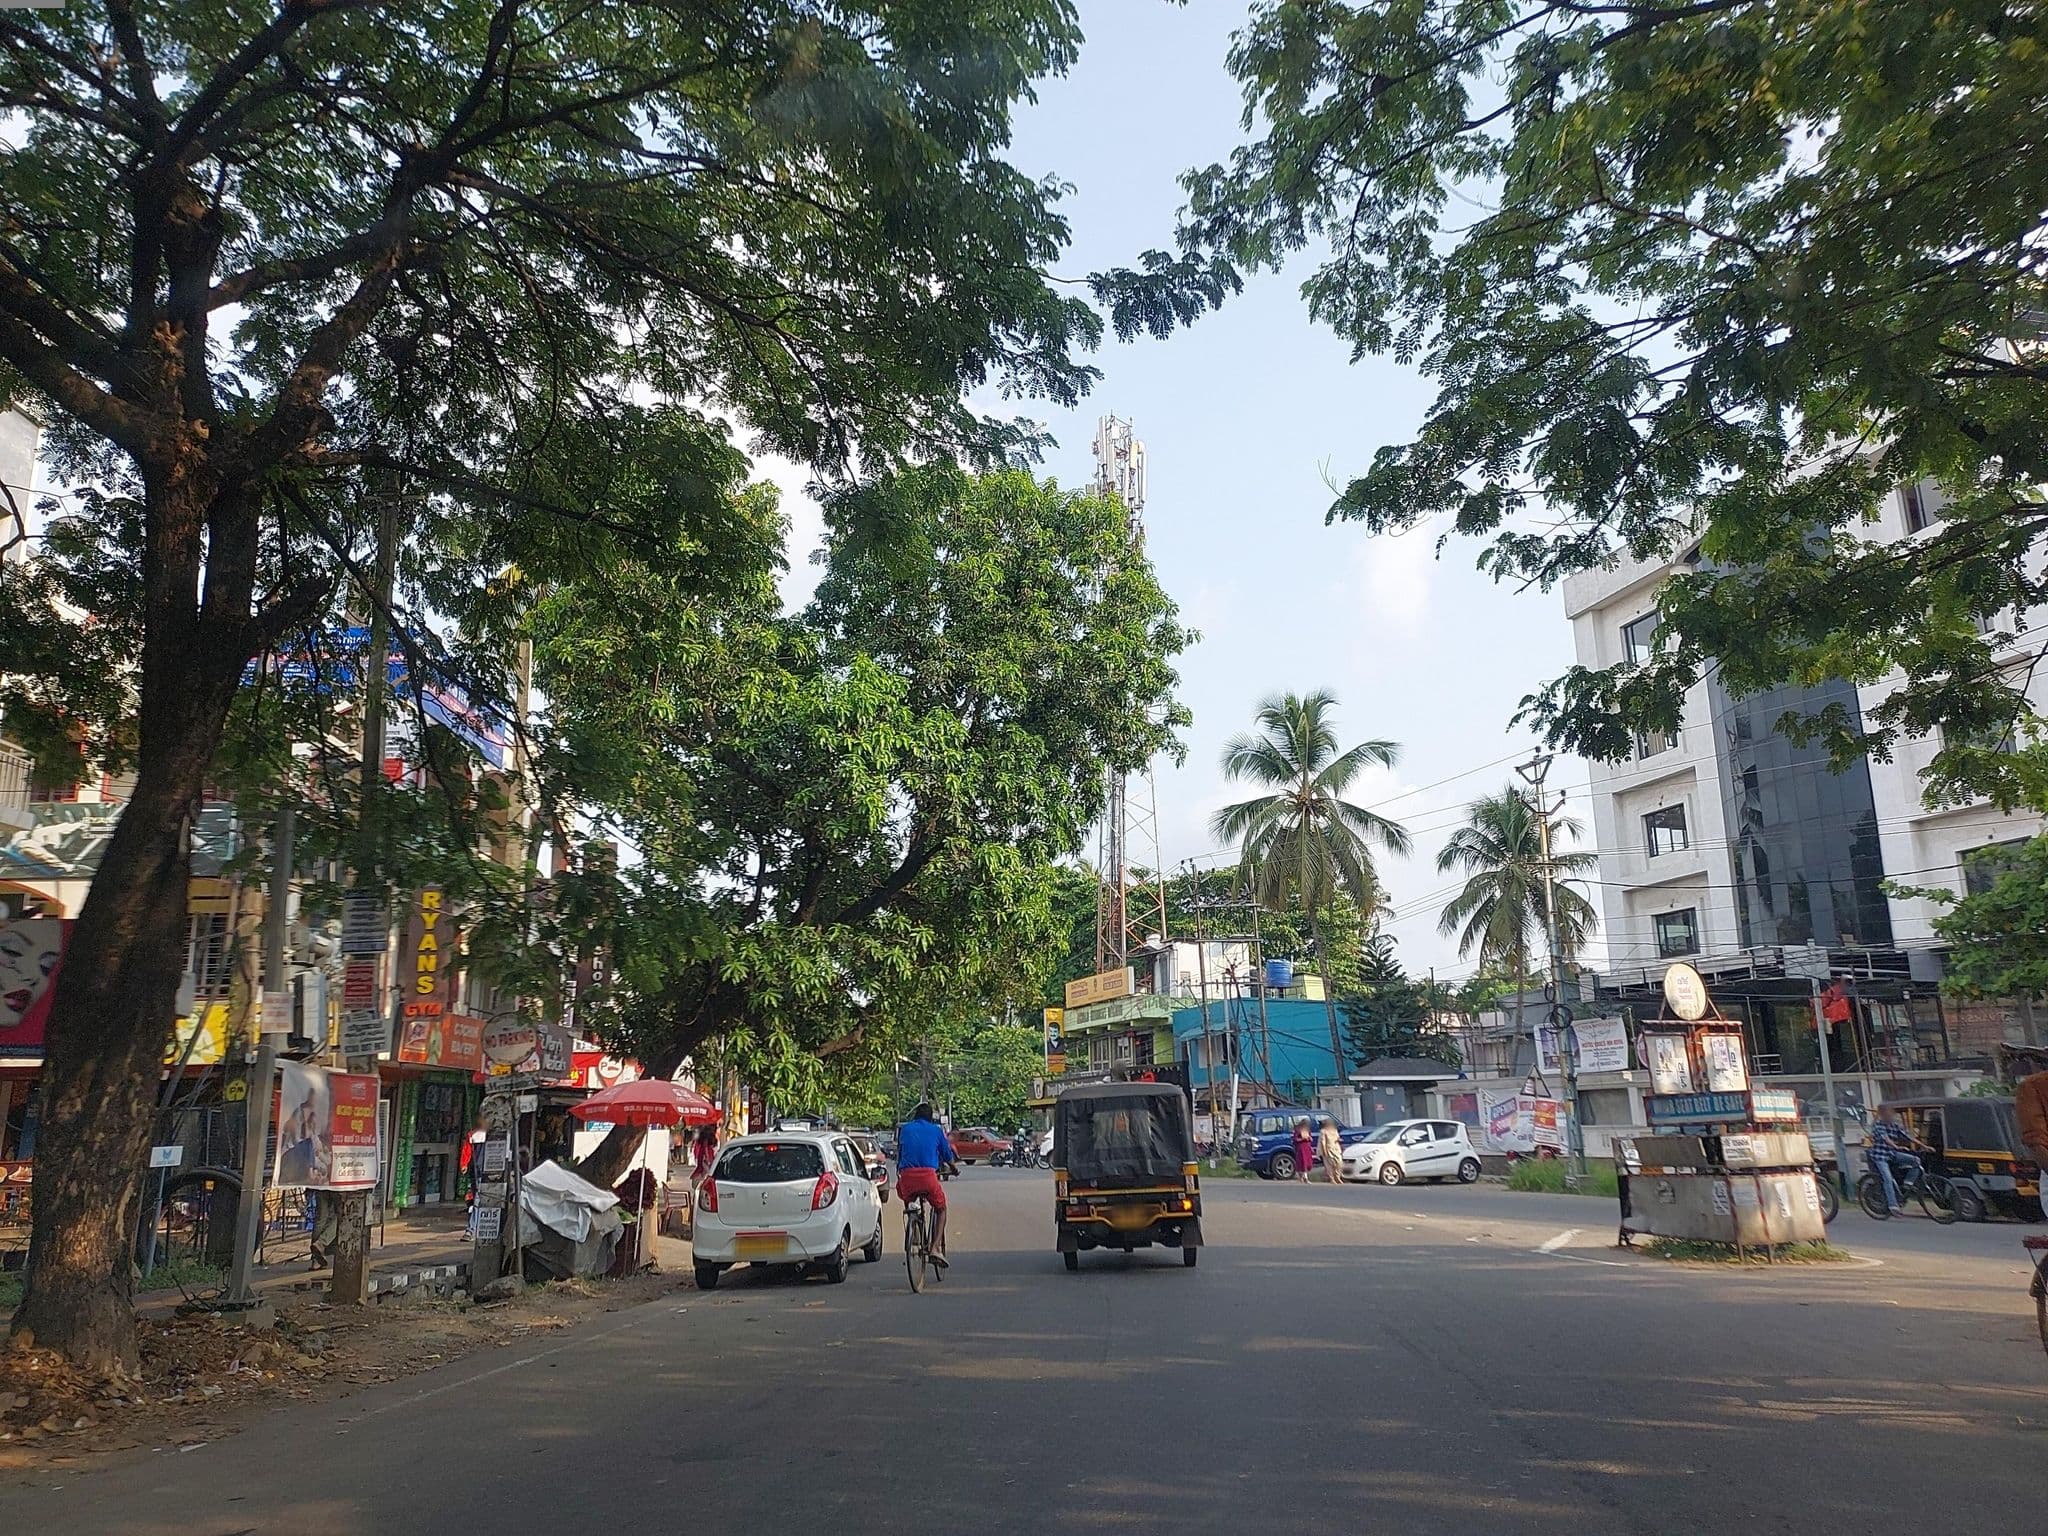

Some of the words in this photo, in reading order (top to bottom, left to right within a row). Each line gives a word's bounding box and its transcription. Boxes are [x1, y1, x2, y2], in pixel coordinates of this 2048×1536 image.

[416, 890, 443, 995] RYANS
[485, 1034, 497, 1049] NO
[498, 1028, 536, 1047] PARKING
